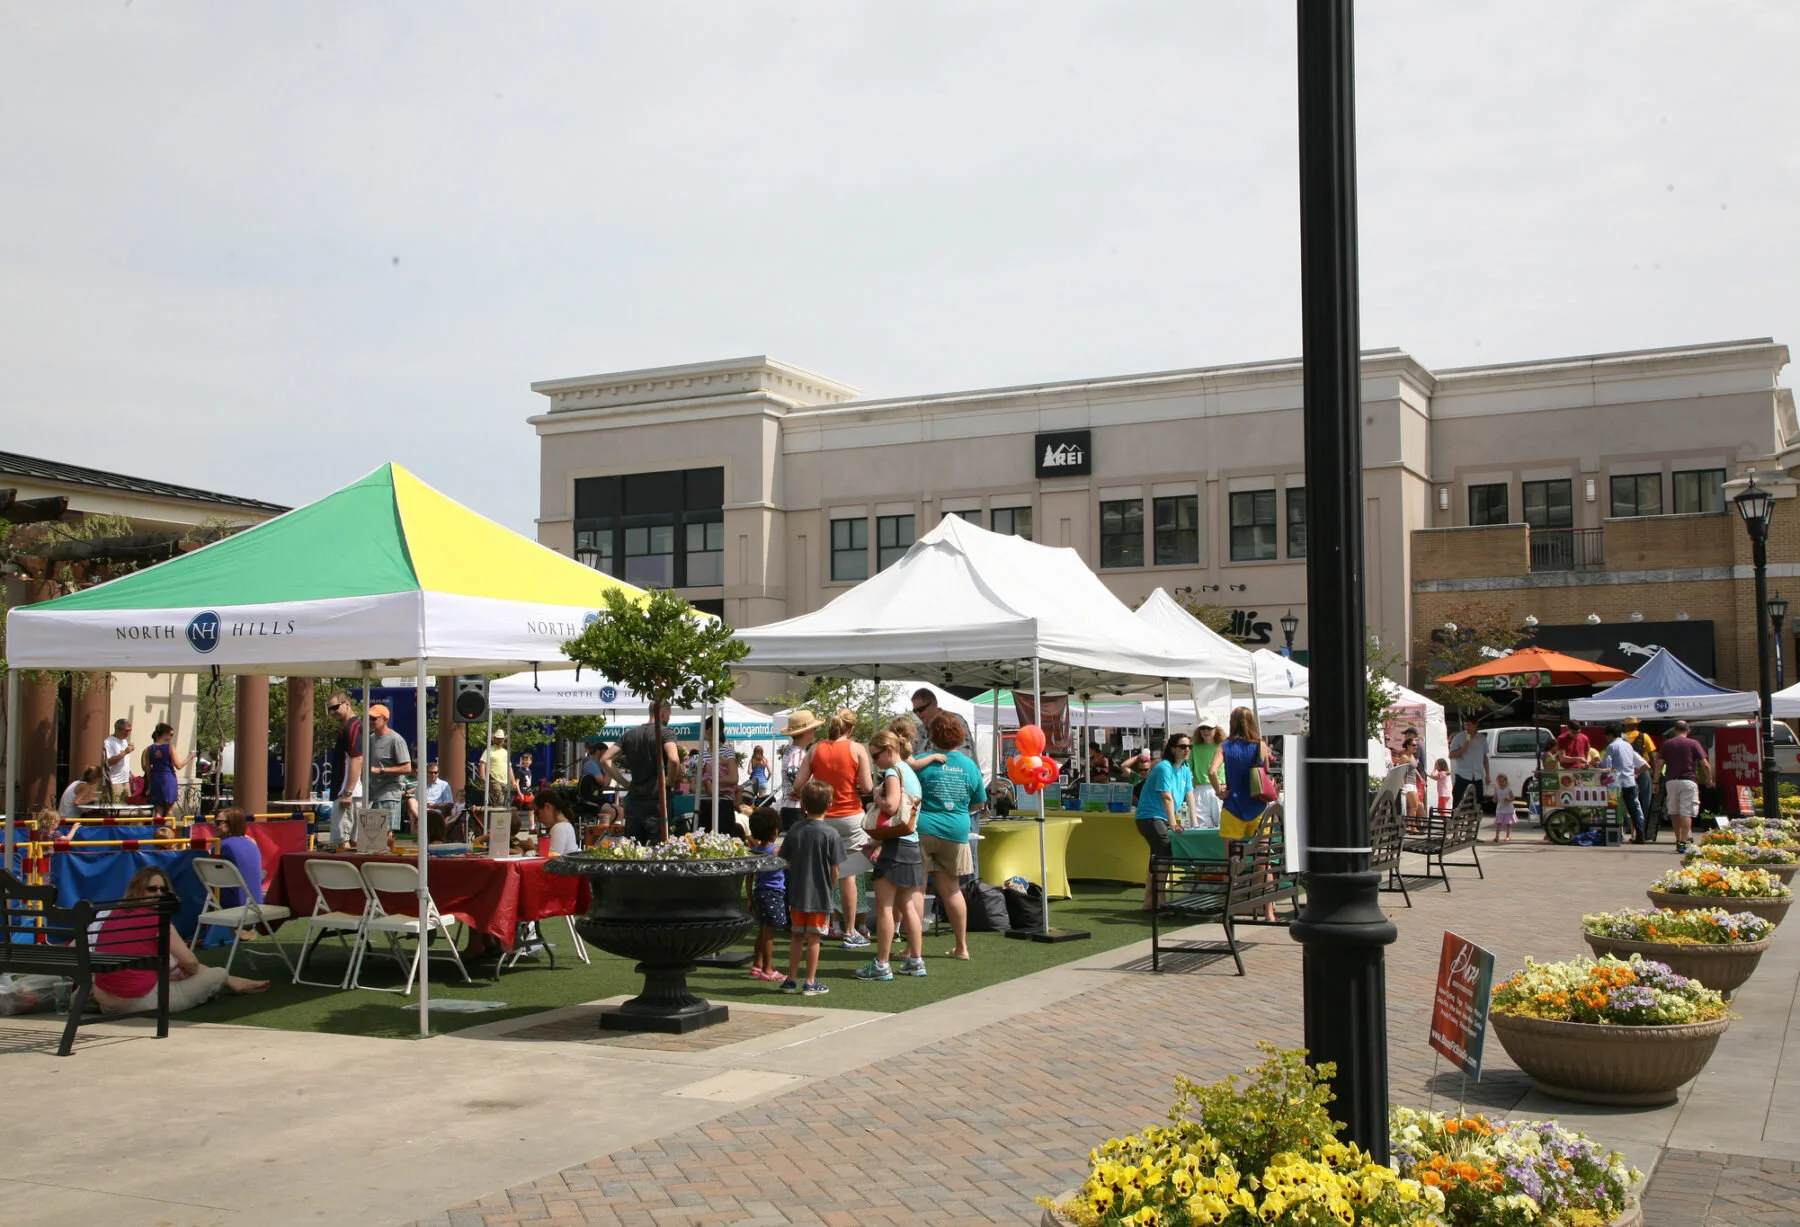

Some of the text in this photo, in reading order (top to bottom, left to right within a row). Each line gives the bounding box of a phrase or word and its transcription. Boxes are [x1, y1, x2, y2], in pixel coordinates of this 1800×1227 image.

[116, 620, 295, 641] NORTH NH HILLS
[527, 621, 576, 636] NORTH
[557, 690, 593, 698] NORTH
